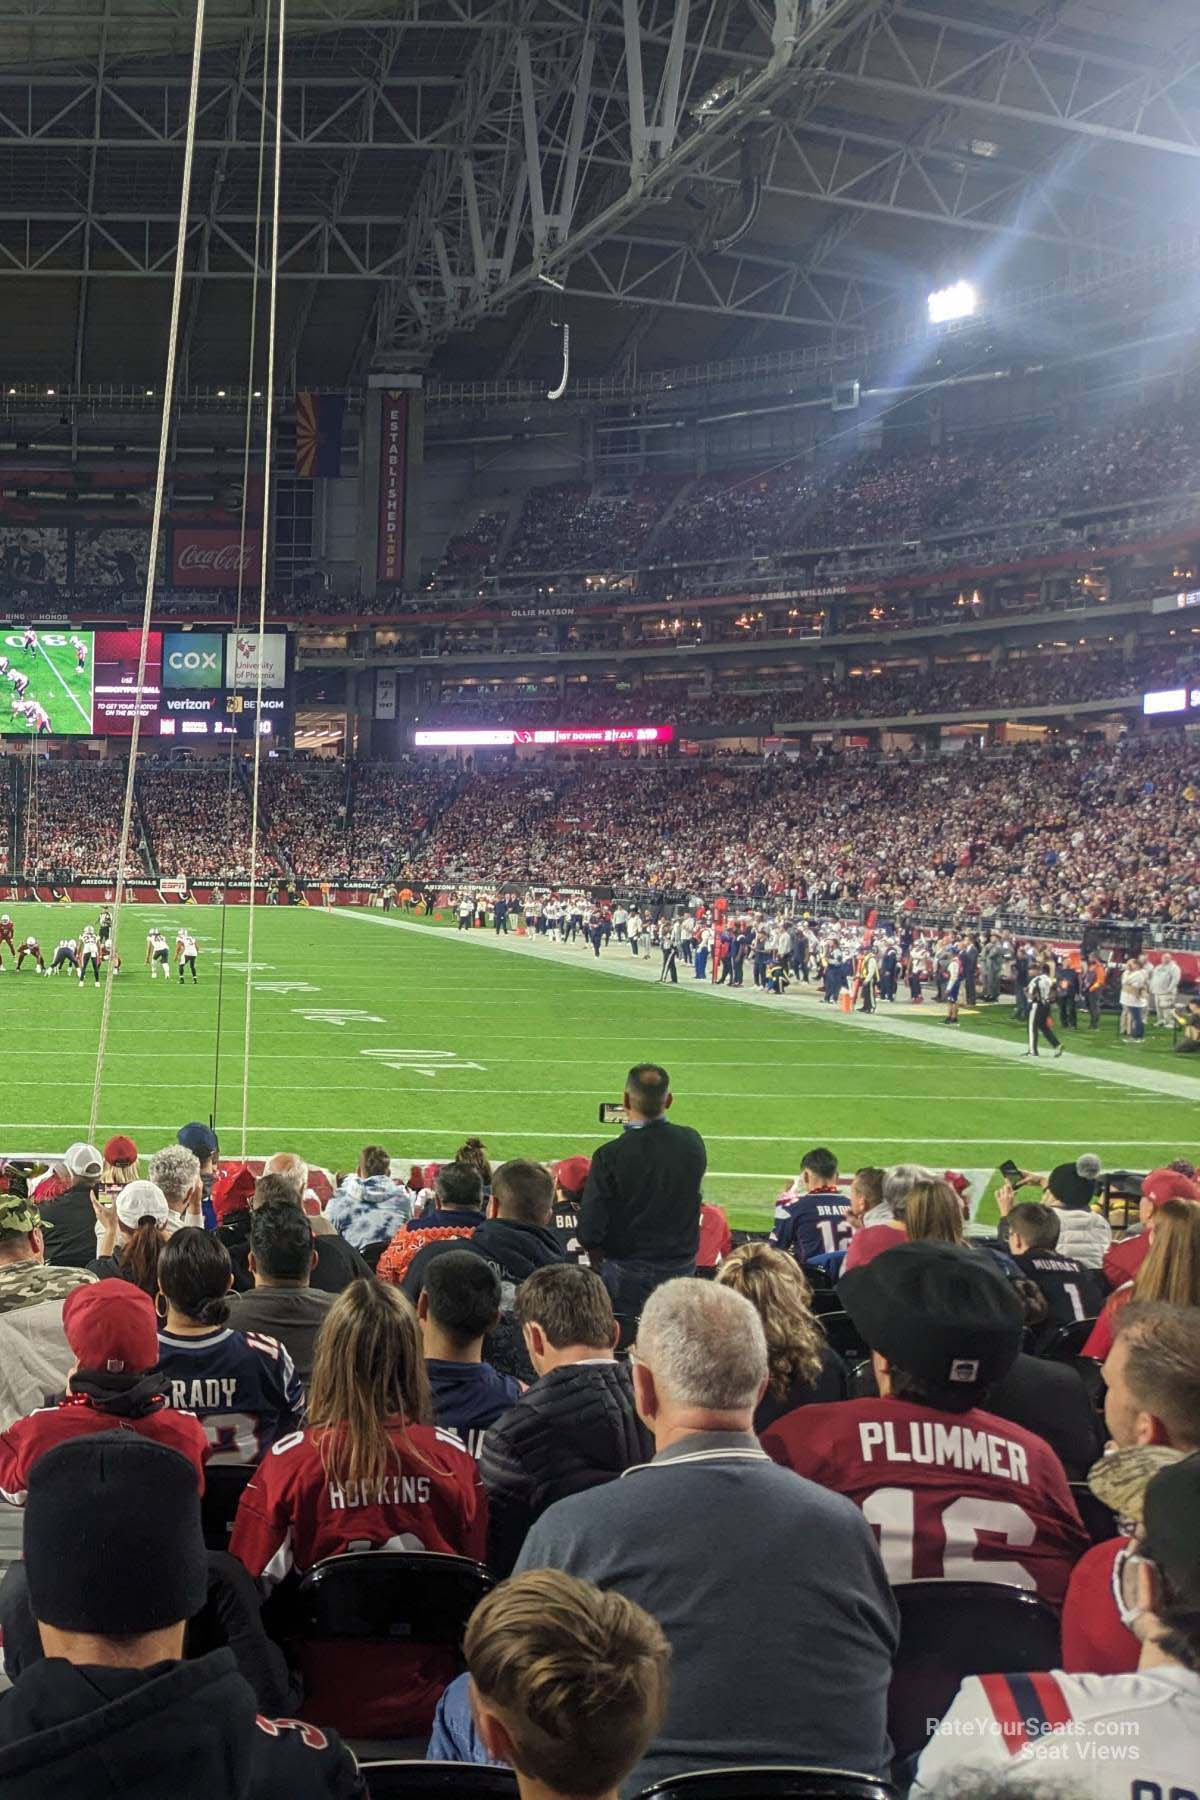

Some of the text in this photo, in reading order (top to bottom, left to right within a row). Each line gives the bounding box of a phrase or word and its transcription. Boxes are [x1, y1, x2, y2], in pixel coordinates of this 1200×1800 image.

[386, 410, 400, 532] ESTABLISHED
[800, 586, 847, 597] WILLIAMS
[511, 608, 575, 617] OLLIE MATSON
[168, 652, 217, 669] COX
[167, 698, 211, 710] verizon
[816, 1221, 856, 1254] 12
[1031, 1259, 1080, 1273] MURRAY
[1062, 1283, 1086, 1321] 1
[162, 1377, 237, 1409] RADY
[858, 1421, 1031, 1486] PLUMMER
[860, 1487, 1038, 1592] 16
